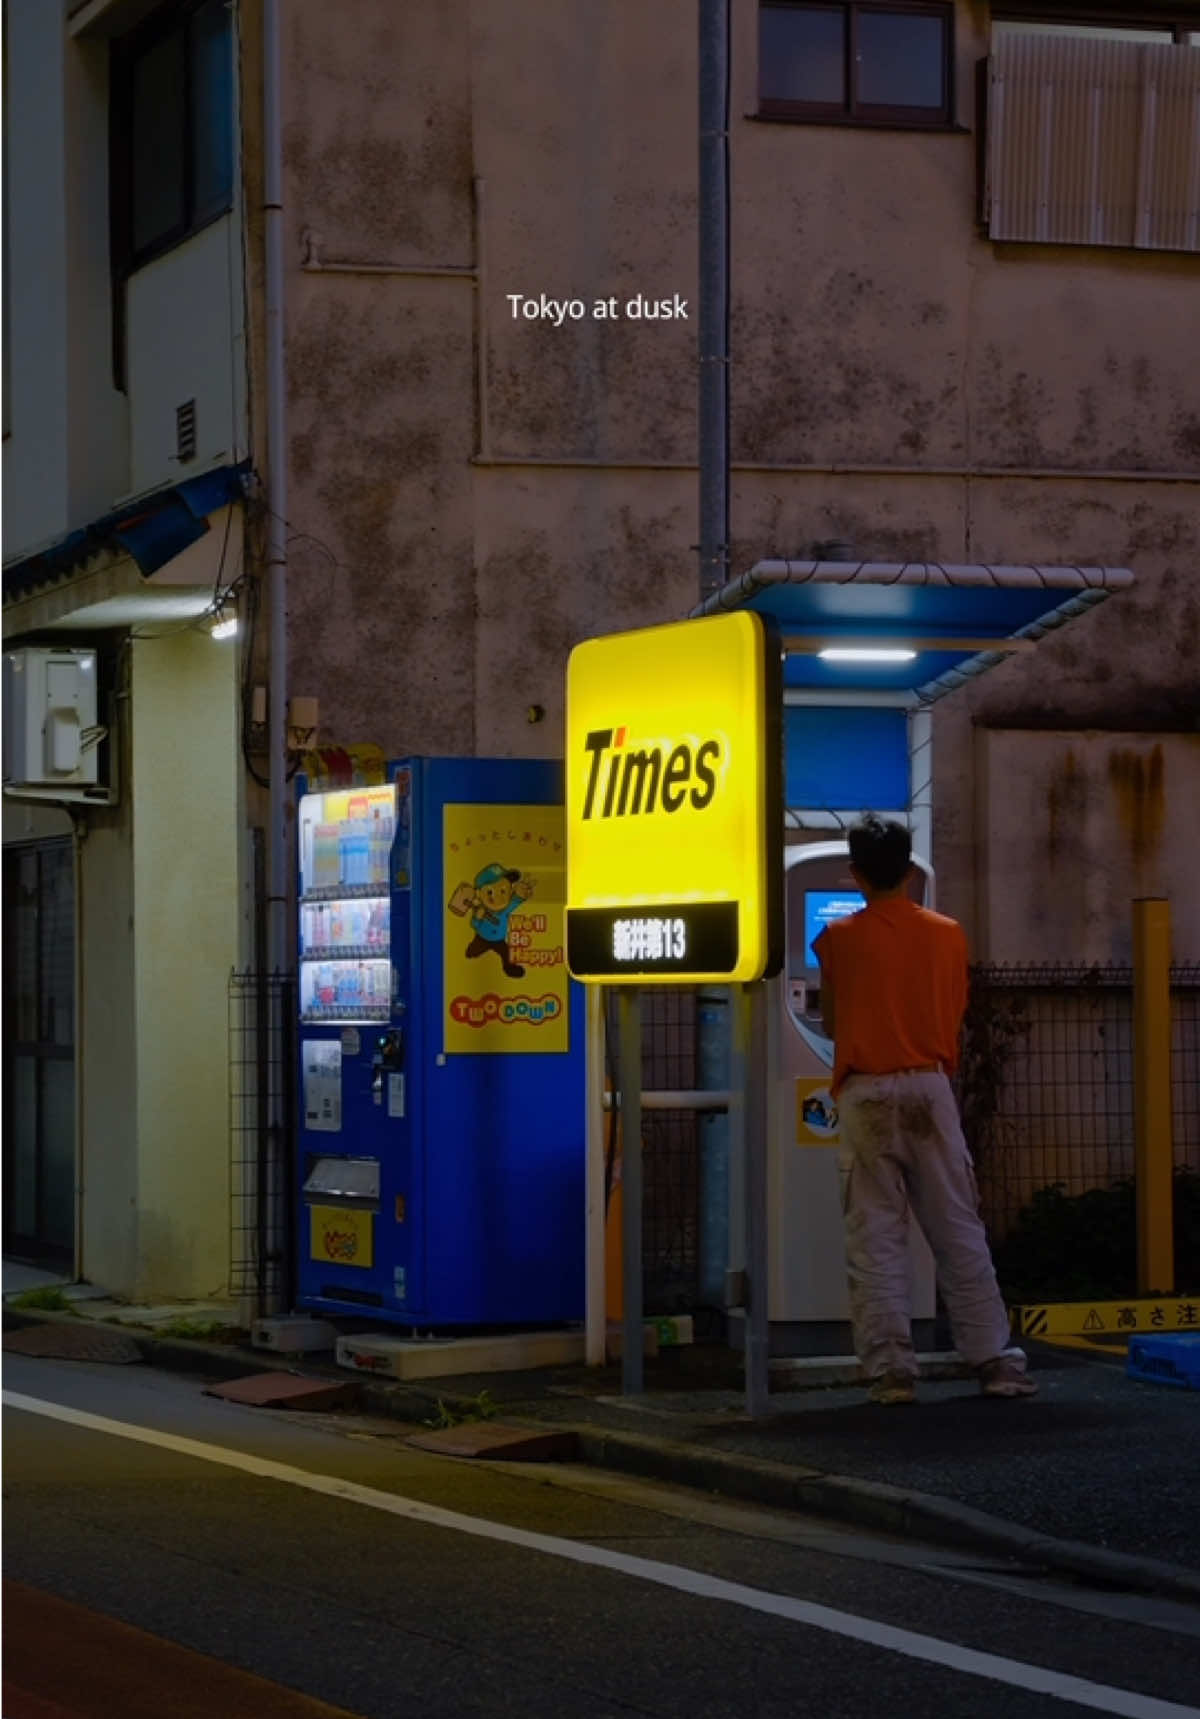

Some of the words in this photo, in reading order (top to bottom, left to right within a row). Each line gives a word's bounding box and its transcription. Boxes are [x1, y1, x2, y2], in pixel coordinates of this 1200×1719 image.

[582, 726, 721, 820] Times
[511, 914, 546, 931] We'll
[509, 931, 531, 947] Be
[509, 947, 563, 967] Happy!
